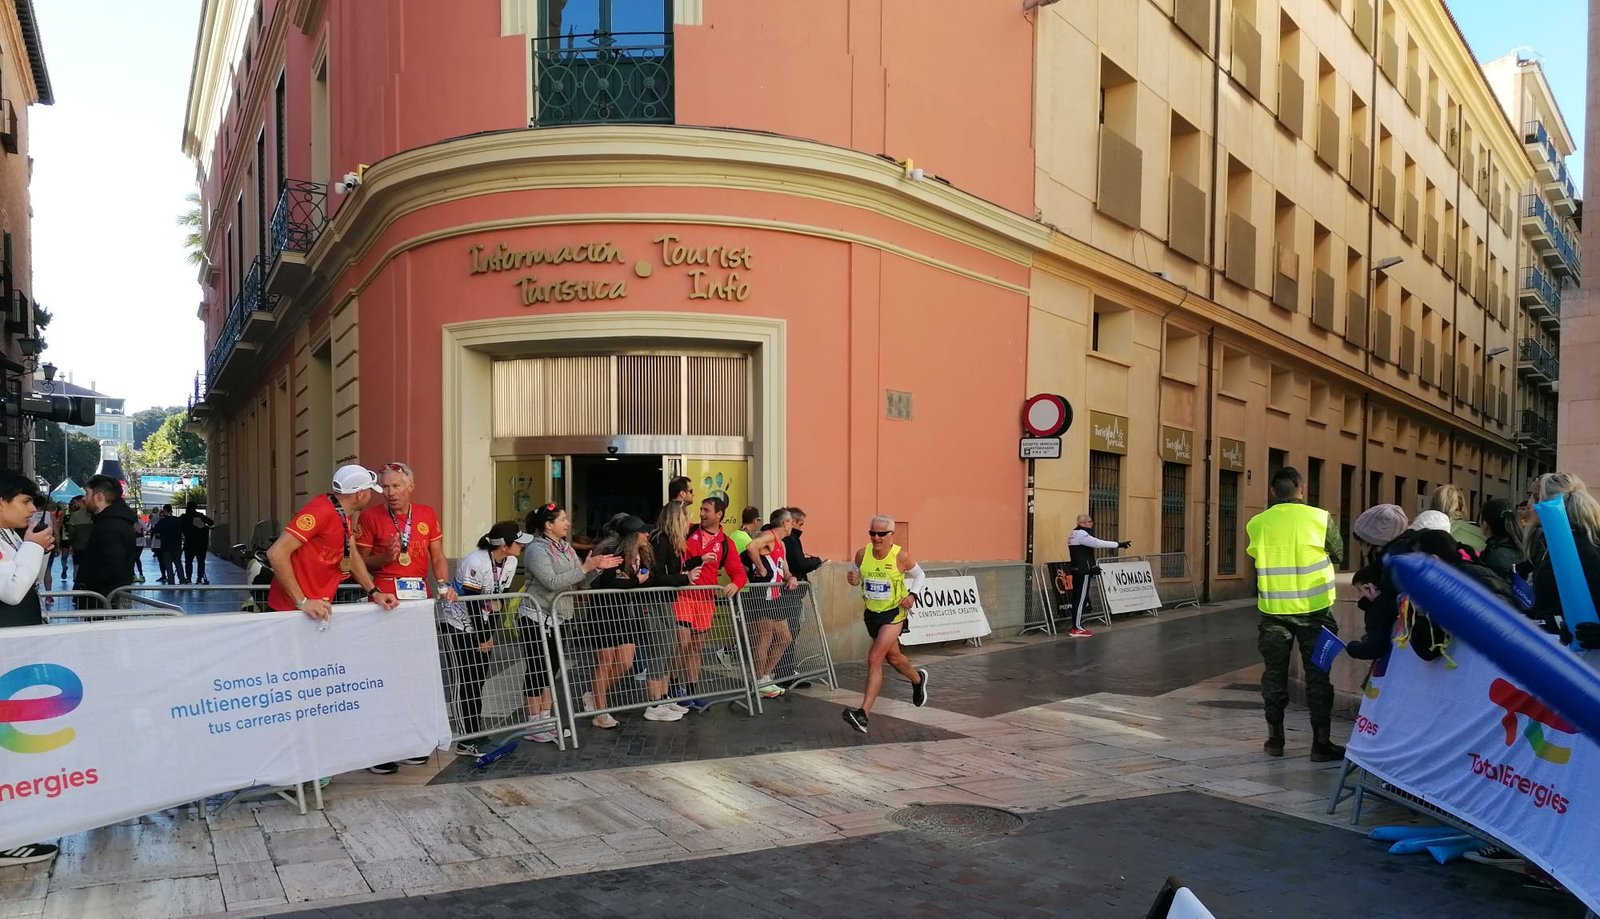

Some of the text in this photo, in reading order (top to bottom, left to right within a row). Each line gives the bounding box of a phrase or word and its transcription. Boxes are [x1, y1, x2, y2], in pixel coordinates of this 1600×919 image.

[469, 241, 625, 276] Información
[653, 234, 753, 270] Tourist
[688, 268, 751, 301] Info
[1115, 569, 1152, 586] NÓMADAS
[914, 586, 976, 609] NÓMADAS
[213, 662, 346, 692] Somos la compañía
[170, 677, 384, 719] multienergías que patrocina
[208, 698, 360, 735] tus carreras preferidas
